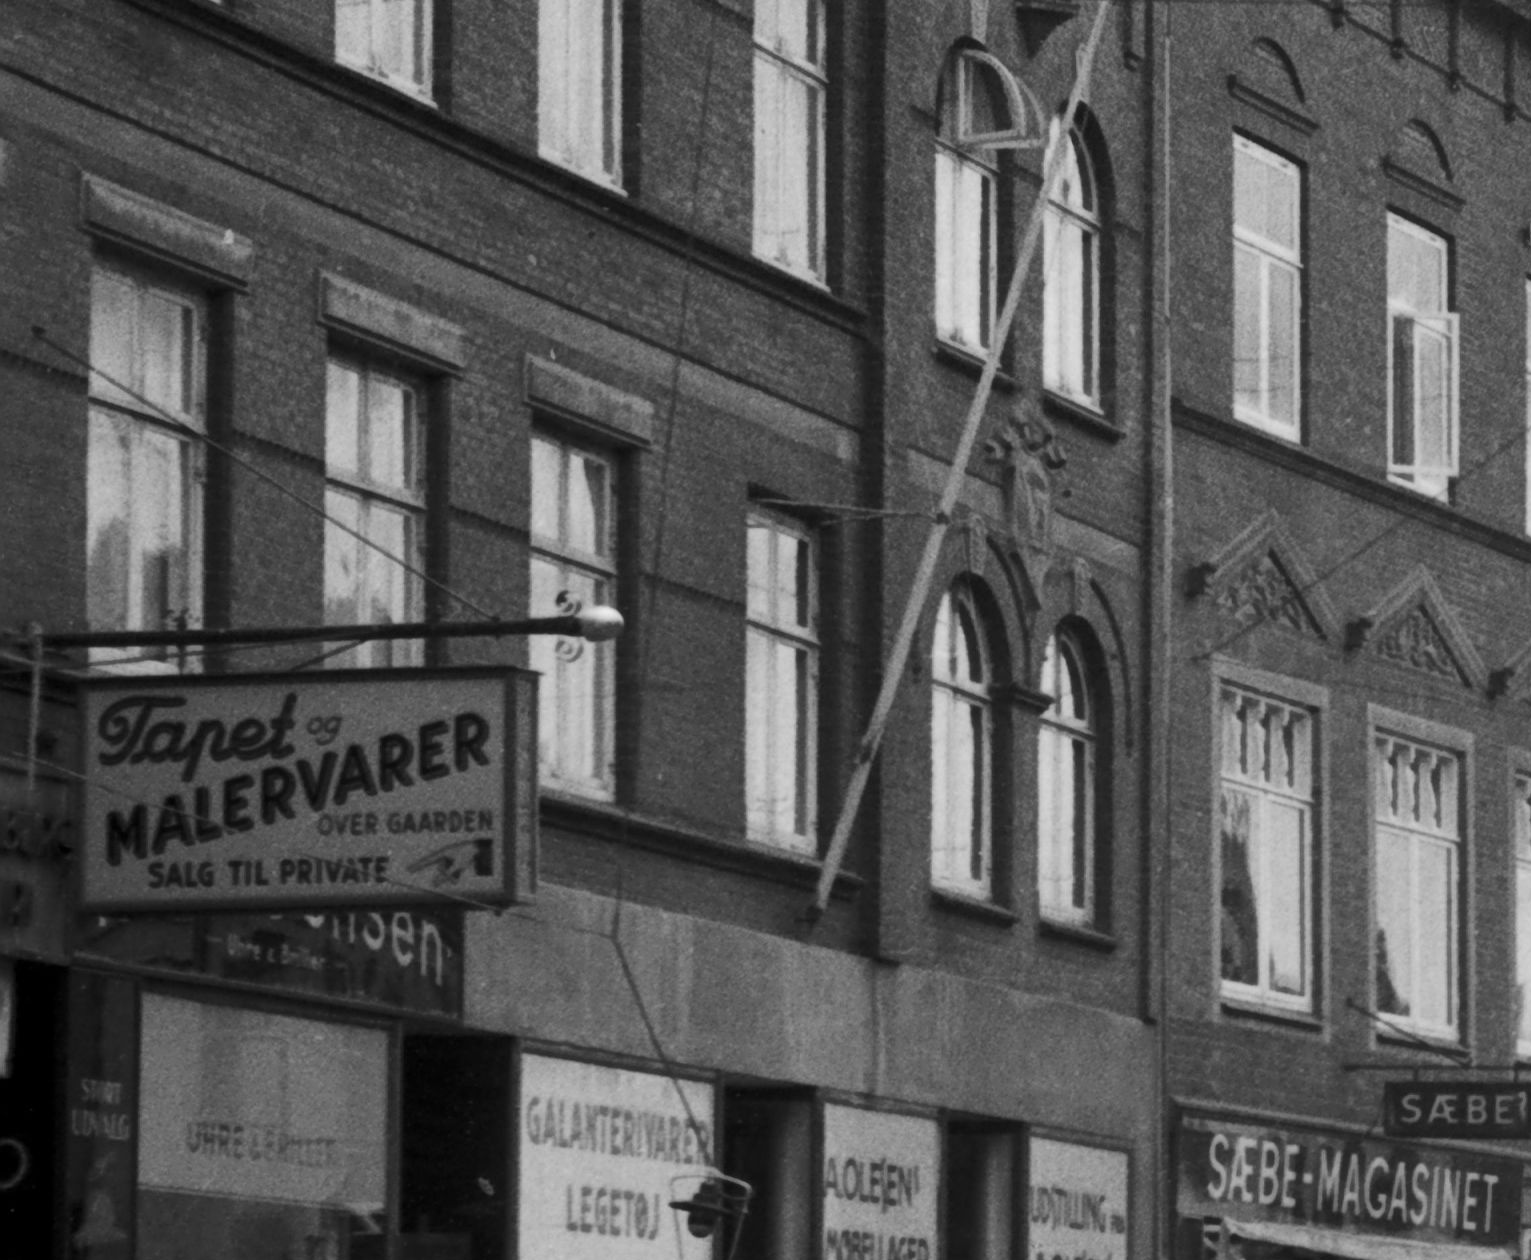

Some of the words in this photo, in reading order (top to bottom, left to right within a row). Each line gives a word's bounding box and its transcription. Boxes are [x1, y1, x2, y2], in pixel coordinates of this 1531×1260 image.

[98, 692, 298, 782] Tapet
[306, 713, 342, 746] og
[106, 711, 490, 867] MALERVARER
[318, 812, 378, 838] OVER
[386, 807, 494, 836] GAARDEN
[147, 858, 215, 890] SALG
[227, 858, 270, 888] TIL
[279, 856, 390, 886] PRIVATE
[565, 1184, 660, 1242] LEGETØJ
[1208, 1134, 1499, 1233] SÆBE-MAGASINET
